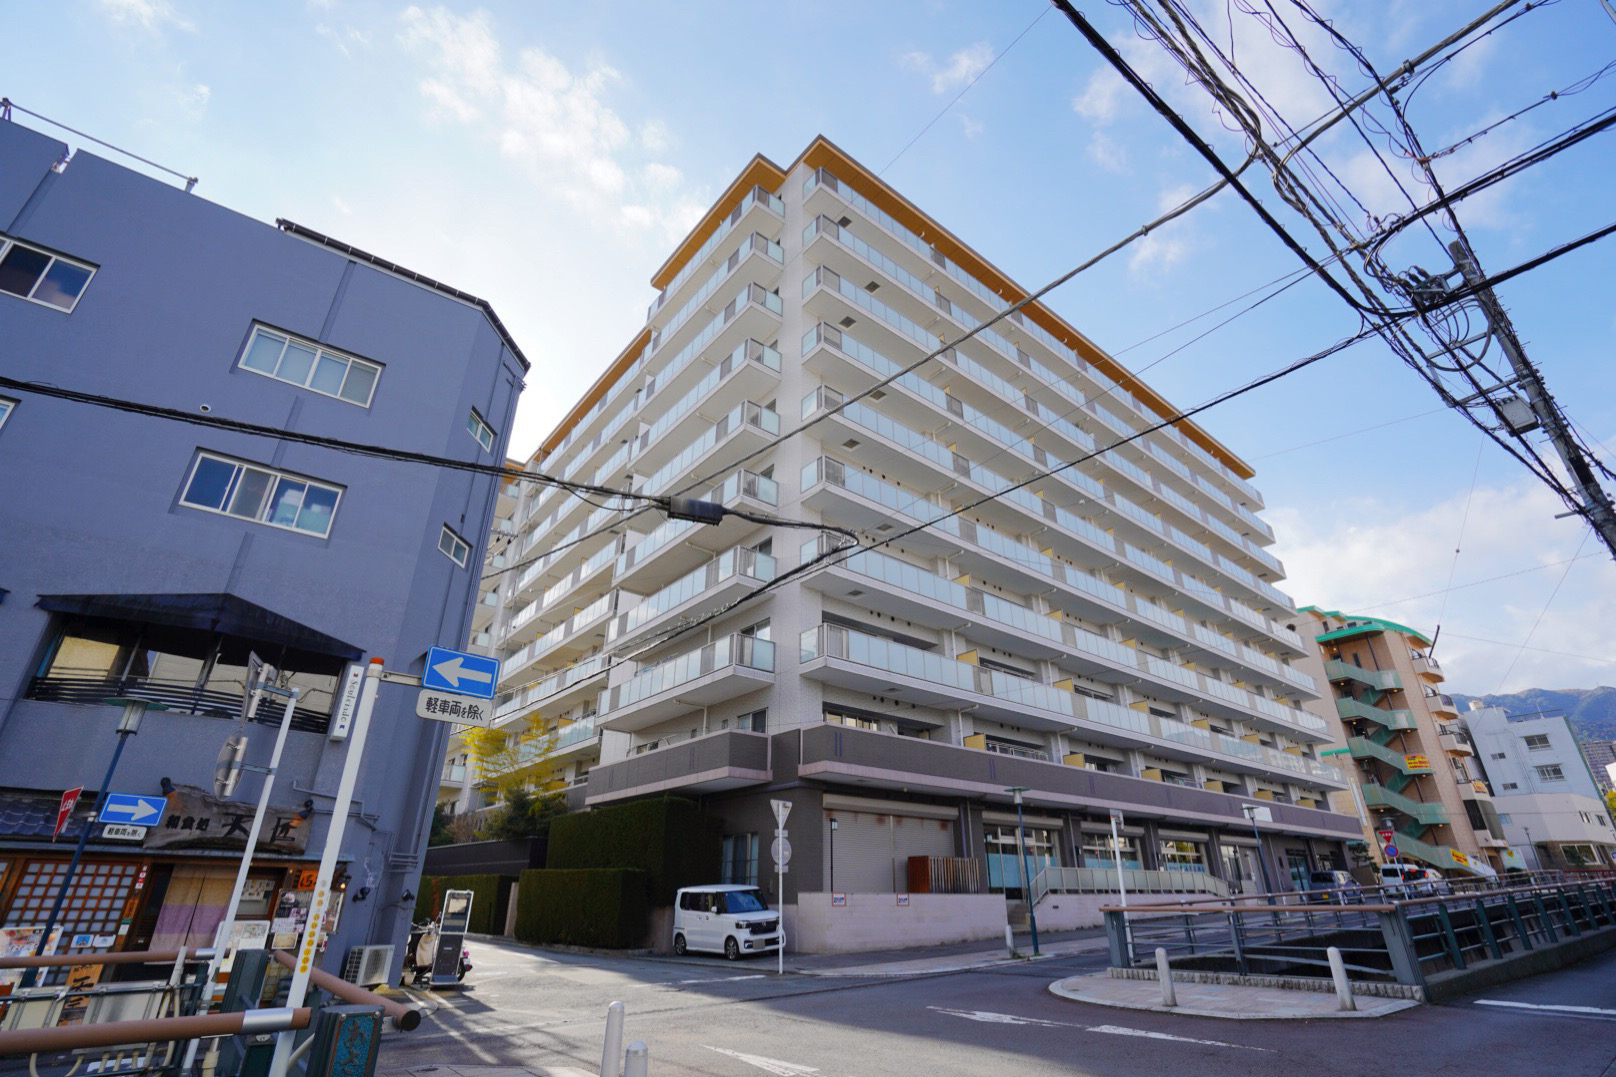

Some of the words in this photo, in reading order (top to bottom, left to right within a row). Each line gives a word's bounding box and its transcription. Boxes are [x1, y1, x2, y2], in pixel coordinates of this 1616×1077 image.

[425, 696, 484, 721] 軽車両を除く
[165, 814, 210, 831] 和食処
